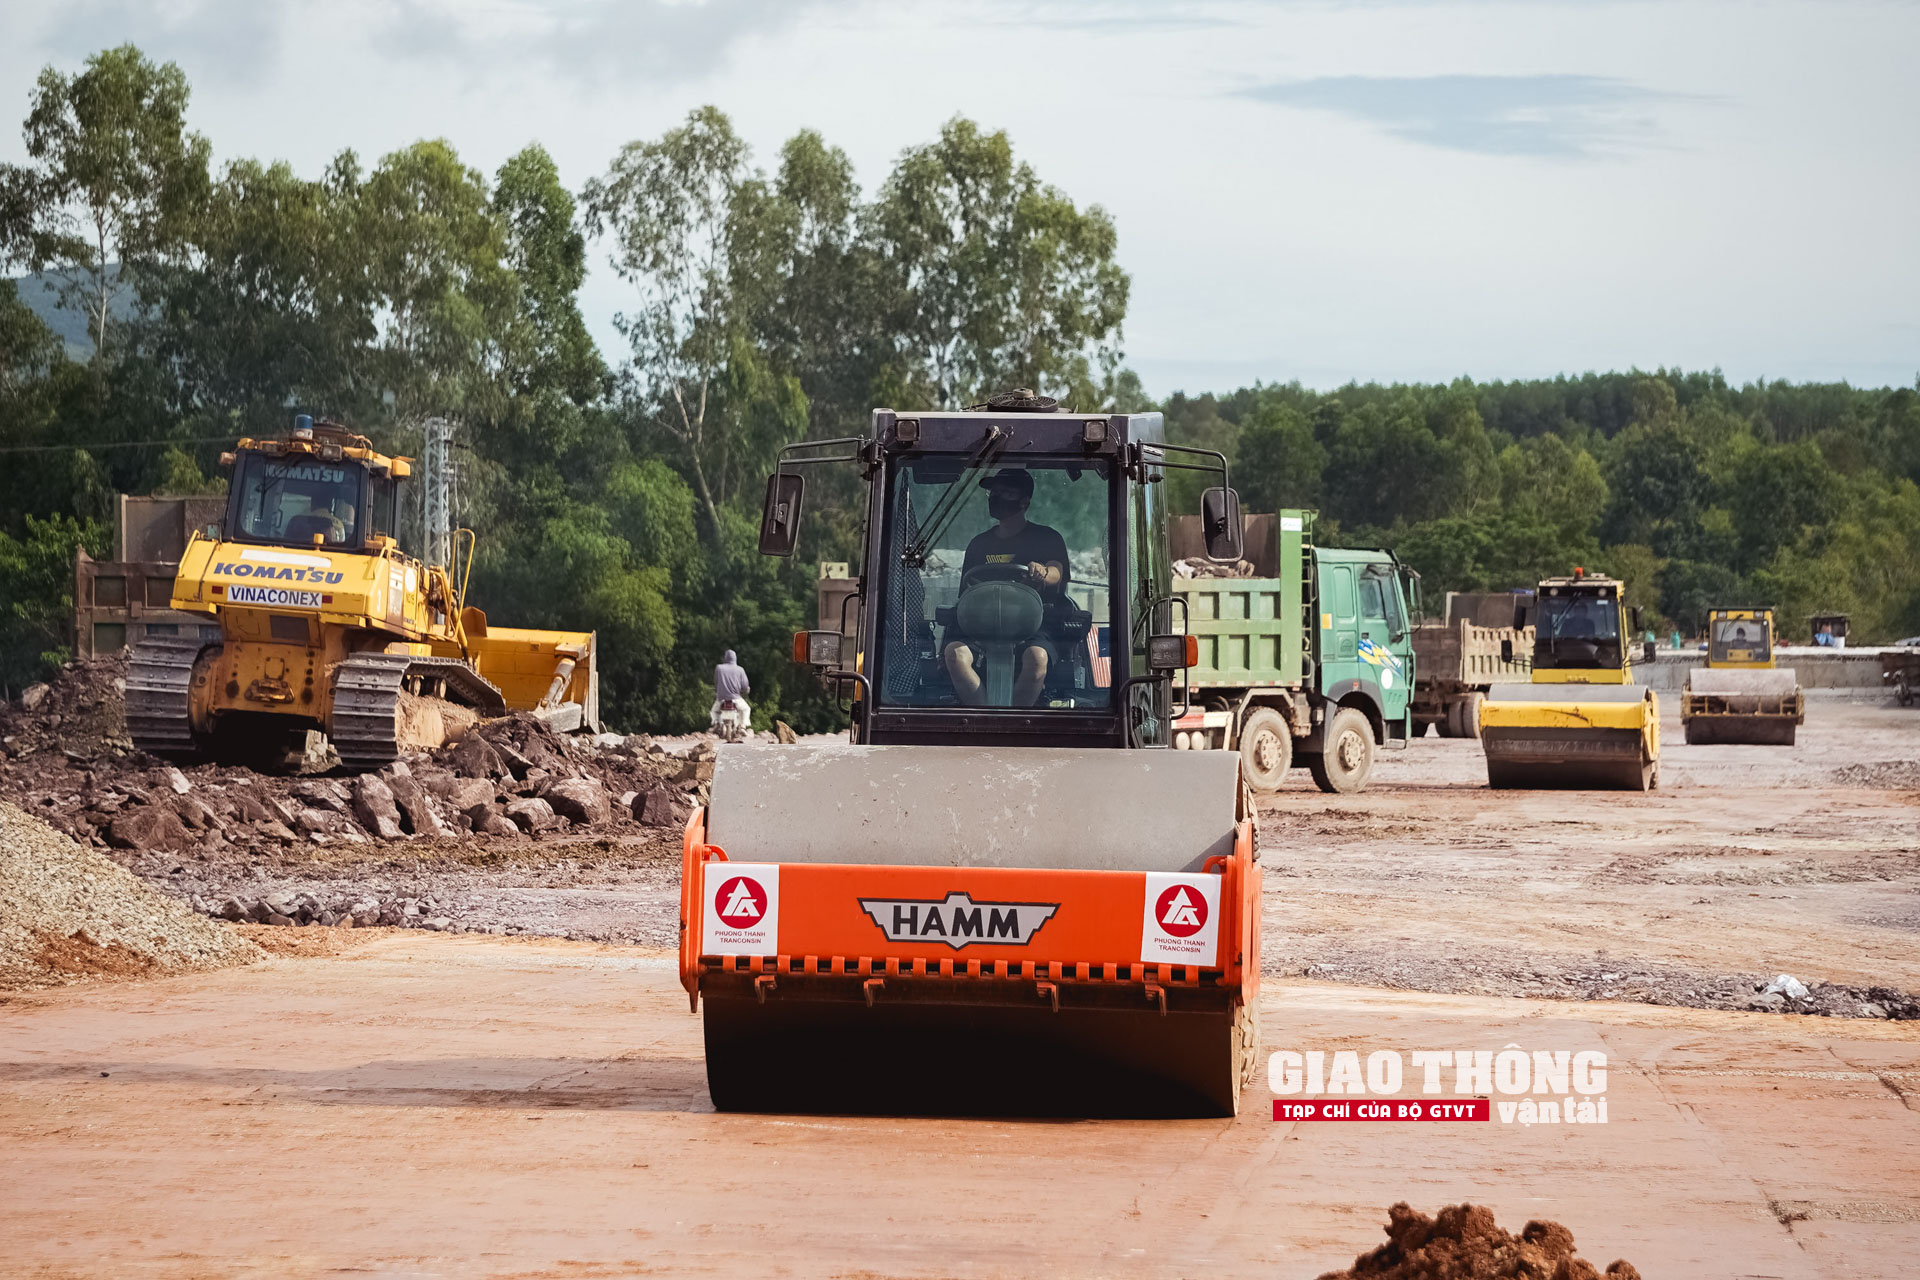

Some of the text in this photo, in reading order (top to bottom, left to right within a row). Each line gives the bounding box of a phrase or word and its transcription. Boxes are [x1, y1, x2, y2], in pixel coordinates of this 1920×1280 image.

[214, 562, 344, 584] KOMATSU
[230, 586, 320, 606] VINACONEX
[892, 905, 1020, 939] HAMM
[1159, 945, 1201, 953] TRANCONSIN
